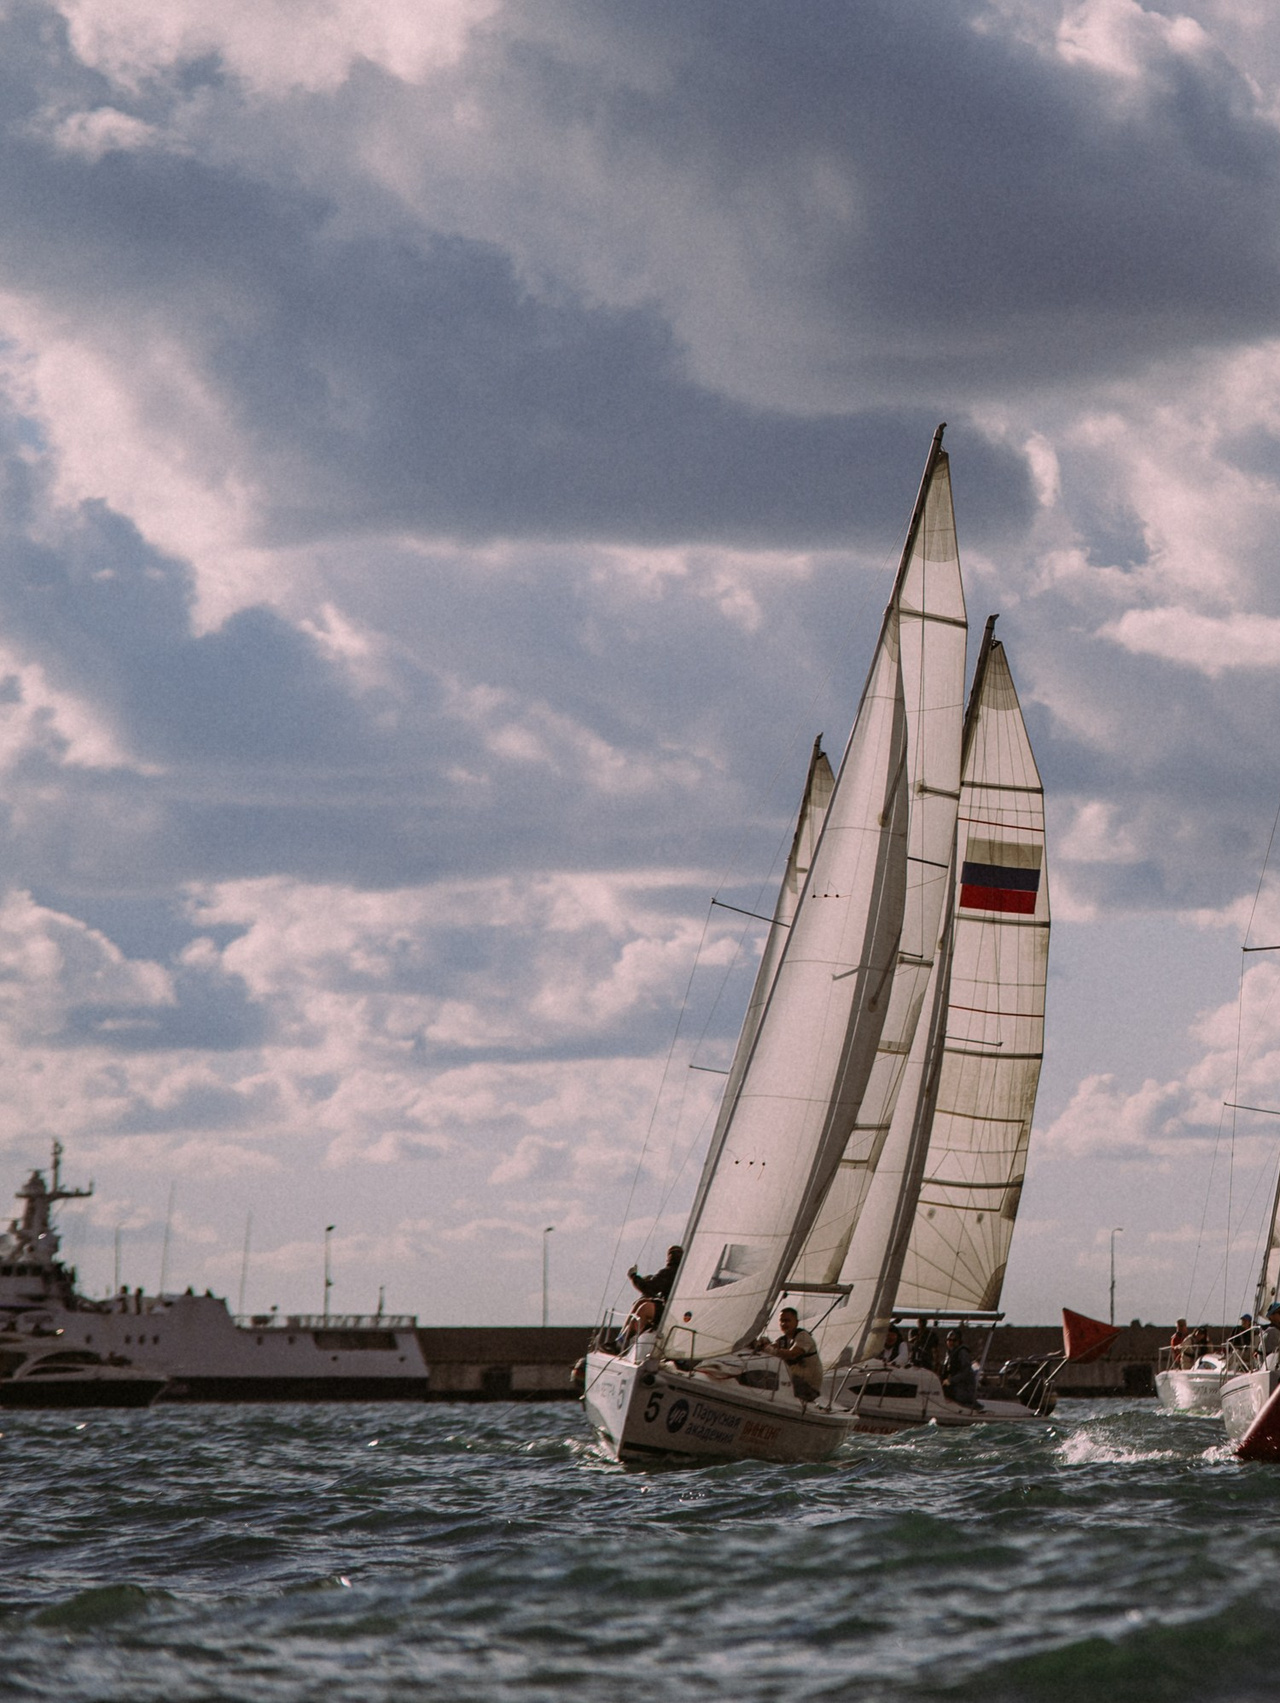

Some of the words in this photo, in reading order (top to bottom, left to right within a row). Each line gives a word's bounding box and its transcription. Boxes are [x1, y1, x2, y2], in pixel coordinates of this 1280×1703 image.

[644, 1392, 664, 1423] 5
[692, 1403, 742, 1430] Парусная
[684, 1423, 735, 1445] академия
